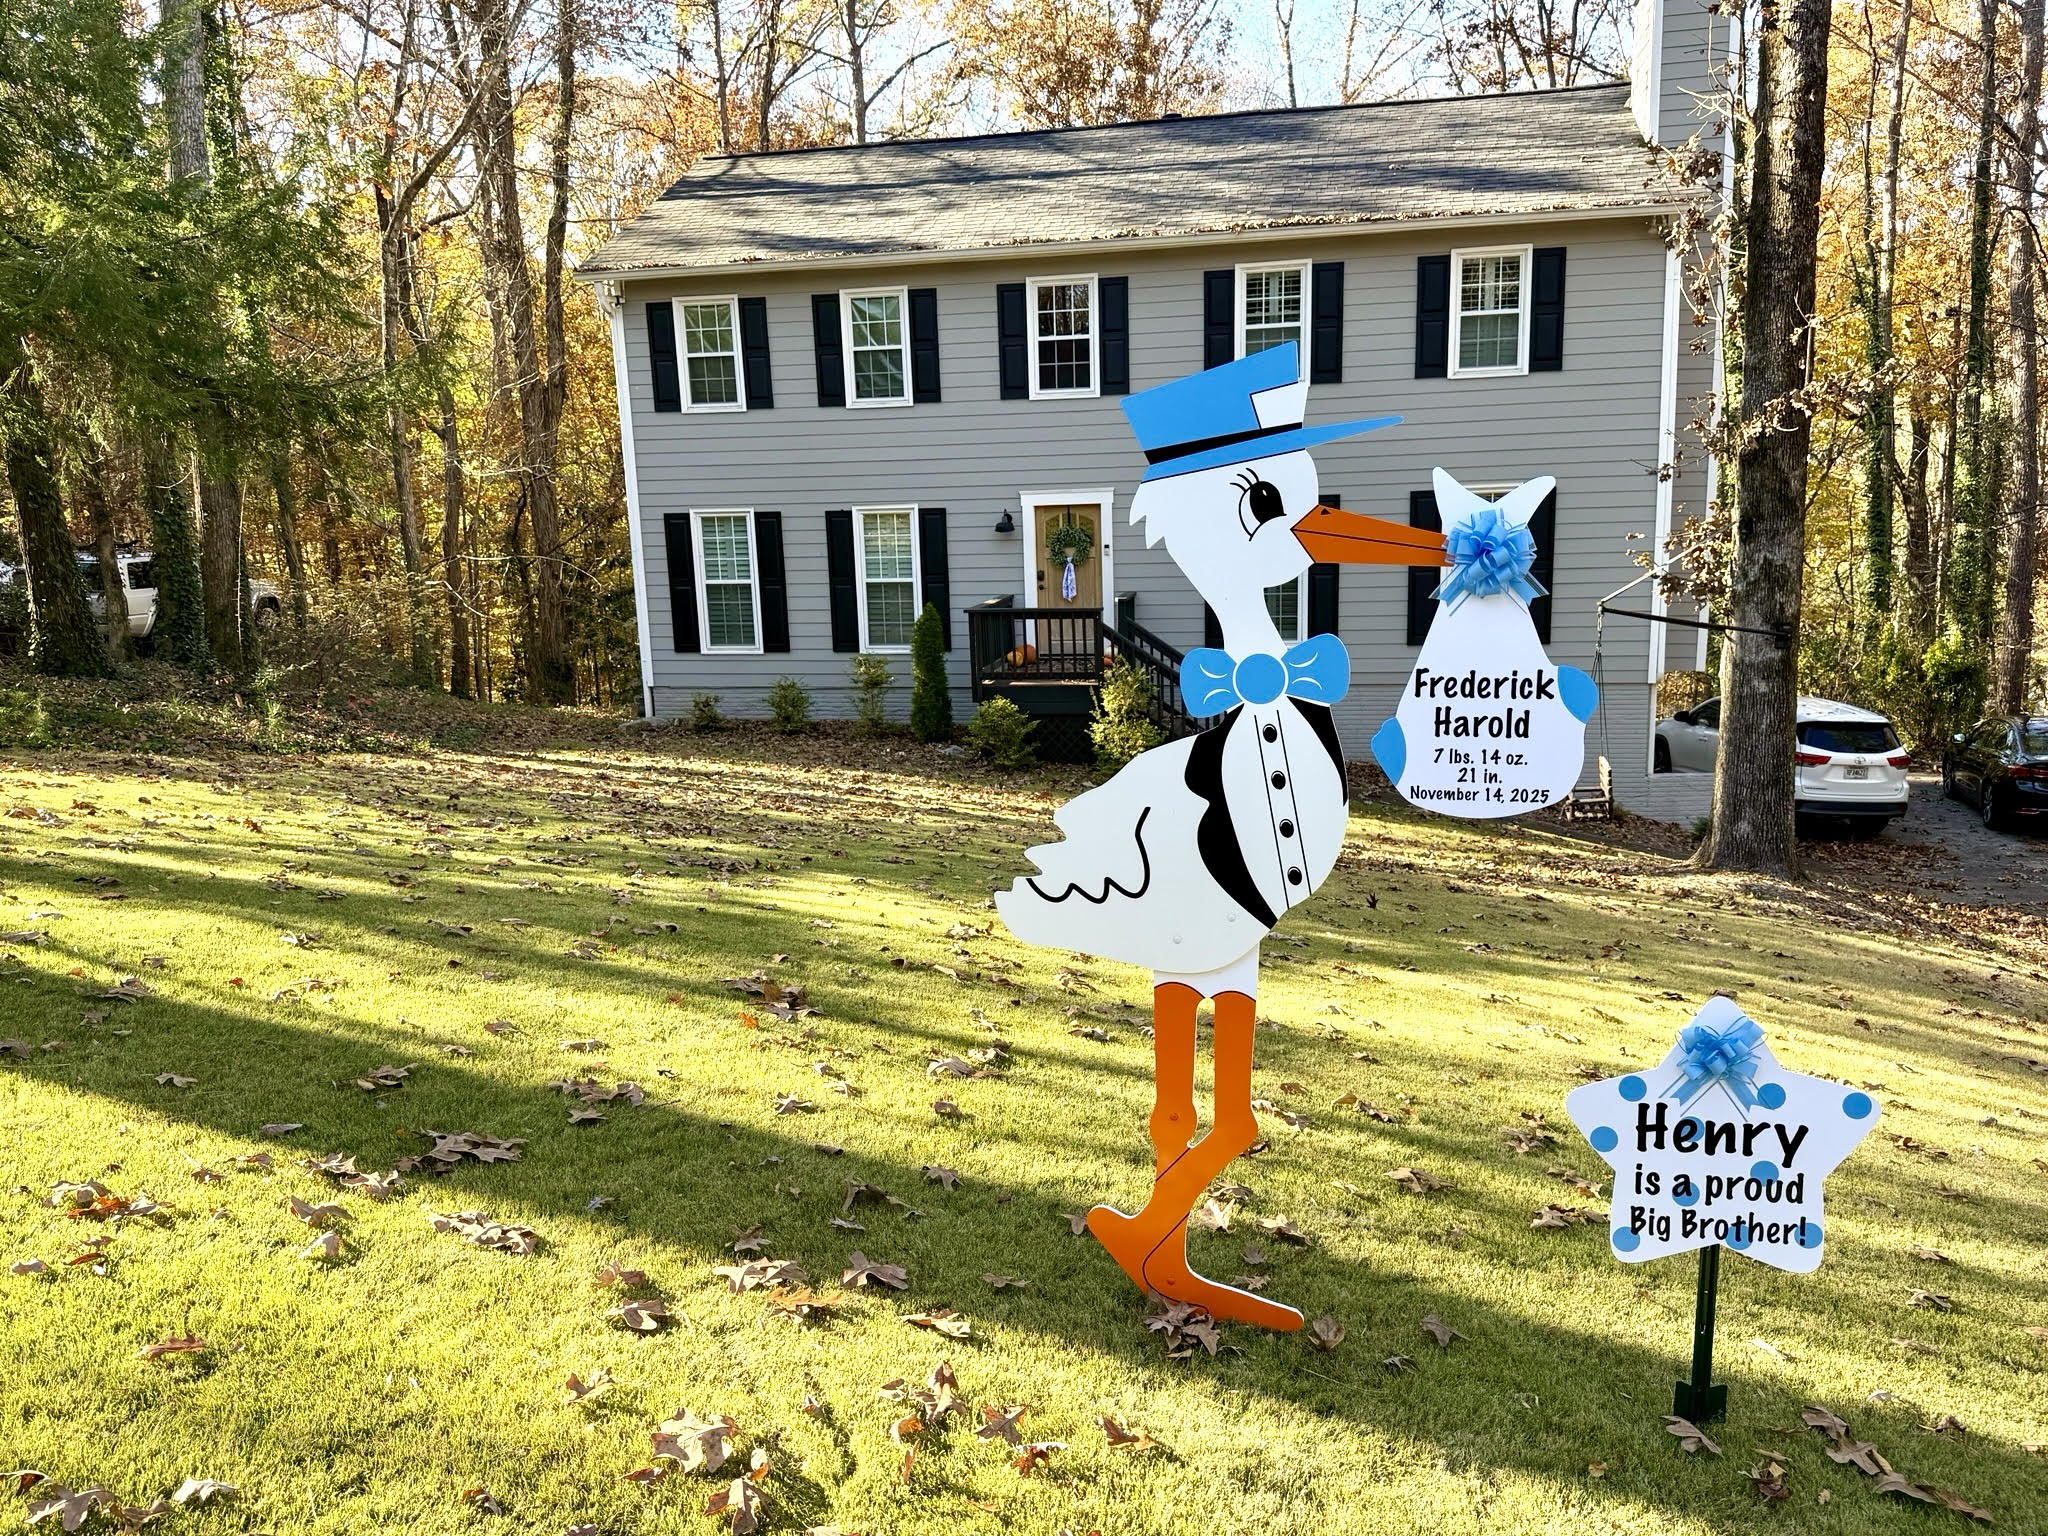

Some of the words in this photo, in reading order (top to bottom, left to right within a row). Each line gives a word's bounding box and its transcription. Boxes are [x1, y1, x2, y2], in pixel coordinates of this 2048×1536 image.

[1414, 667, 1555, 700] Frederick
[1434, 705, 1530, 739] Harold
[1433, 747, 1444, 764] 7
[1449, 748, 1475, 765] lbs.
[1481, 748, 1502, 766] 14
[1506, 753, 1528, 766] oz.
[1457, 767, 1476, 783] 21
[1483, 768, 1502, 784] in.
[1409, 785, 1480, 802] November
[1485, 787, 1505, 804] 14,
[1509, 788, 1550, 804] 2025
[1635, 1102, 1809, 1168] Henry
[1635, 1163, 1661, 1196] is
[1671, 1173, 1693, 1198] a
[1704, 1172, 1805, 1206] proud
[1630, 1205, 1671, 1242] Big
[1681, 1208, 1807, 1246] Brother!
